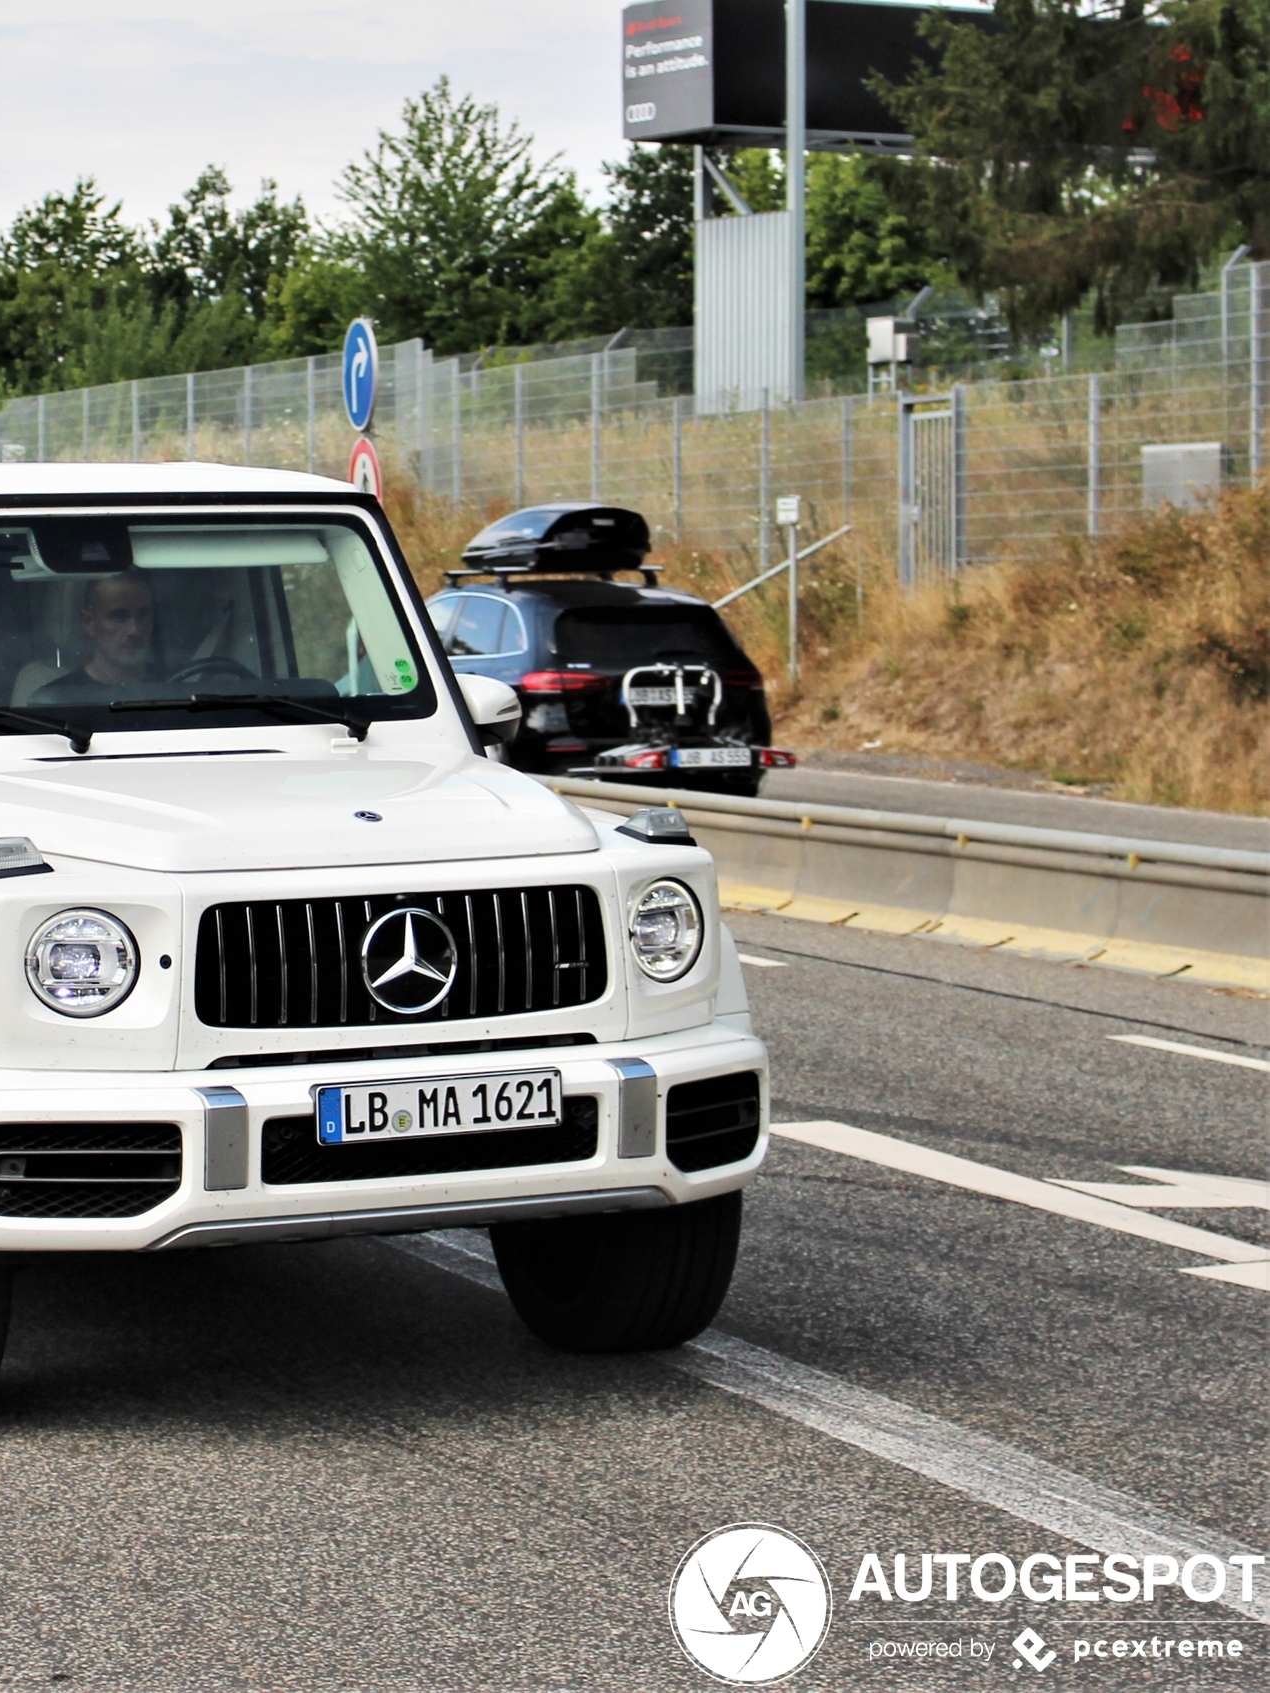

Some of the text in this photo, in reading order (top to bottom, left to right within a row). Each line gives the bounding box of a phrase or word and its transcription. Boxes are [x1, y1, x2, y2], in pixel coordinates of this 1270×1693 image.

[625, 36, 703, 59] Performance
[625, 53, 709, 78] is an attitude.
[326, 1078, 557, 1134] D LB MA 1621
